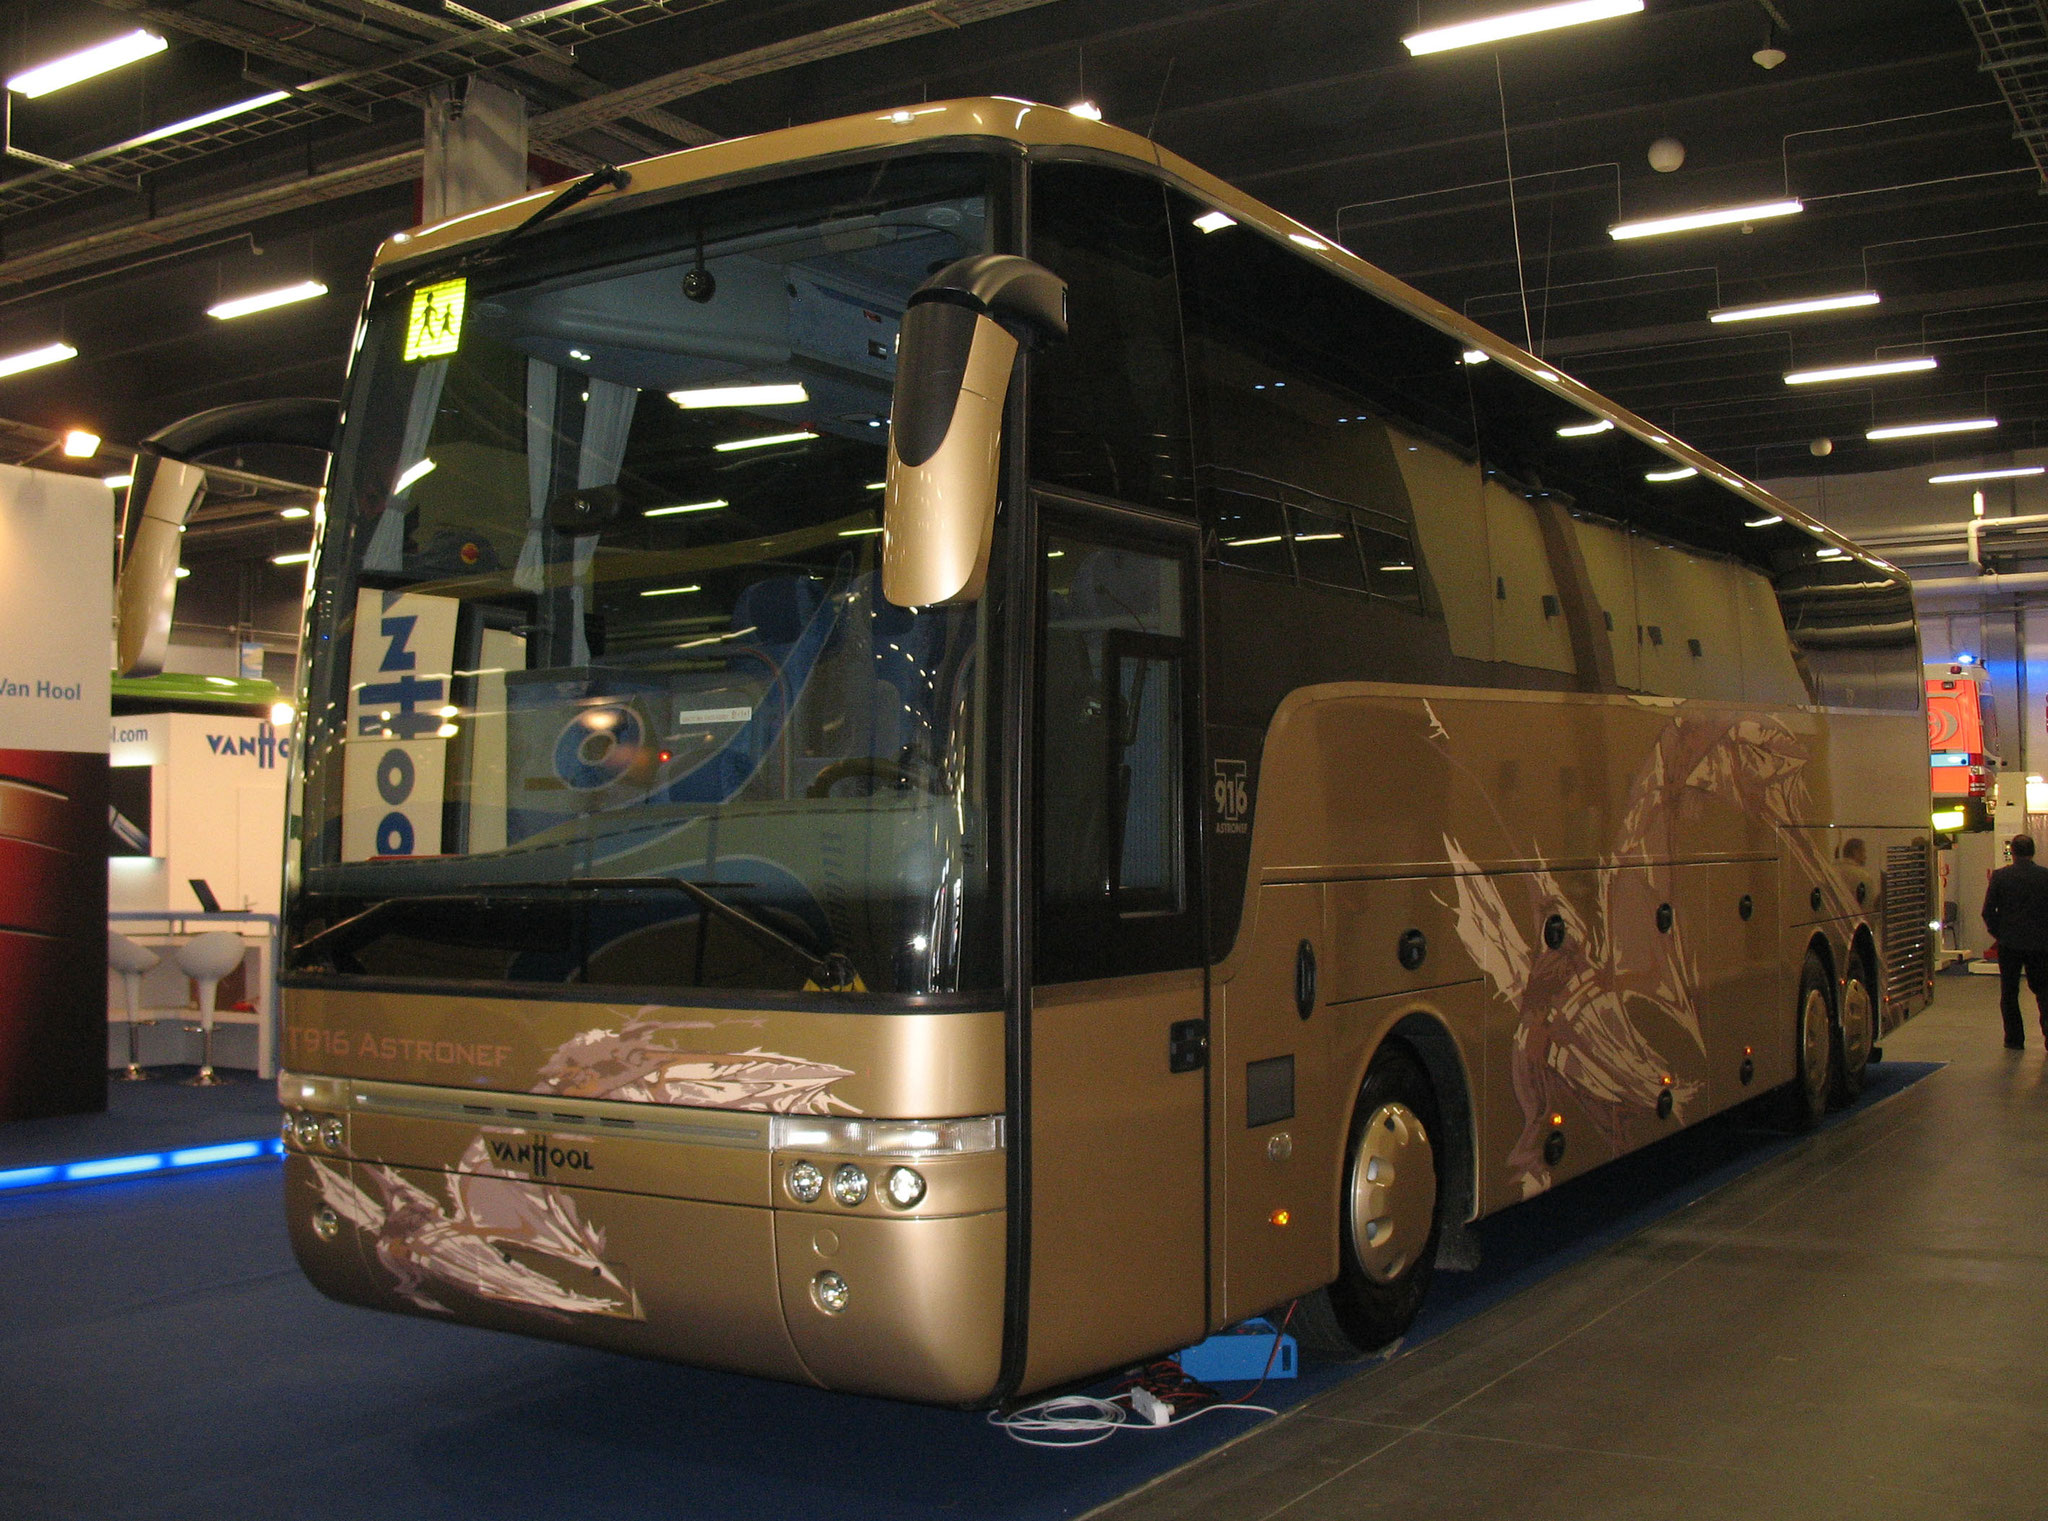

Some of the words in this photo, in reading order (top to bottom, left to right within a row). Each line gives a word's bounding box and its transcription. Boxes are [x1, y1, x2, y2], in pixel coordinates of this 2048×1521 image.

[37, 680, 81, 700] Hool
[287, 1025, 350, 1056] T916
[358, 1032, 513, 1068] ASTRONEF
